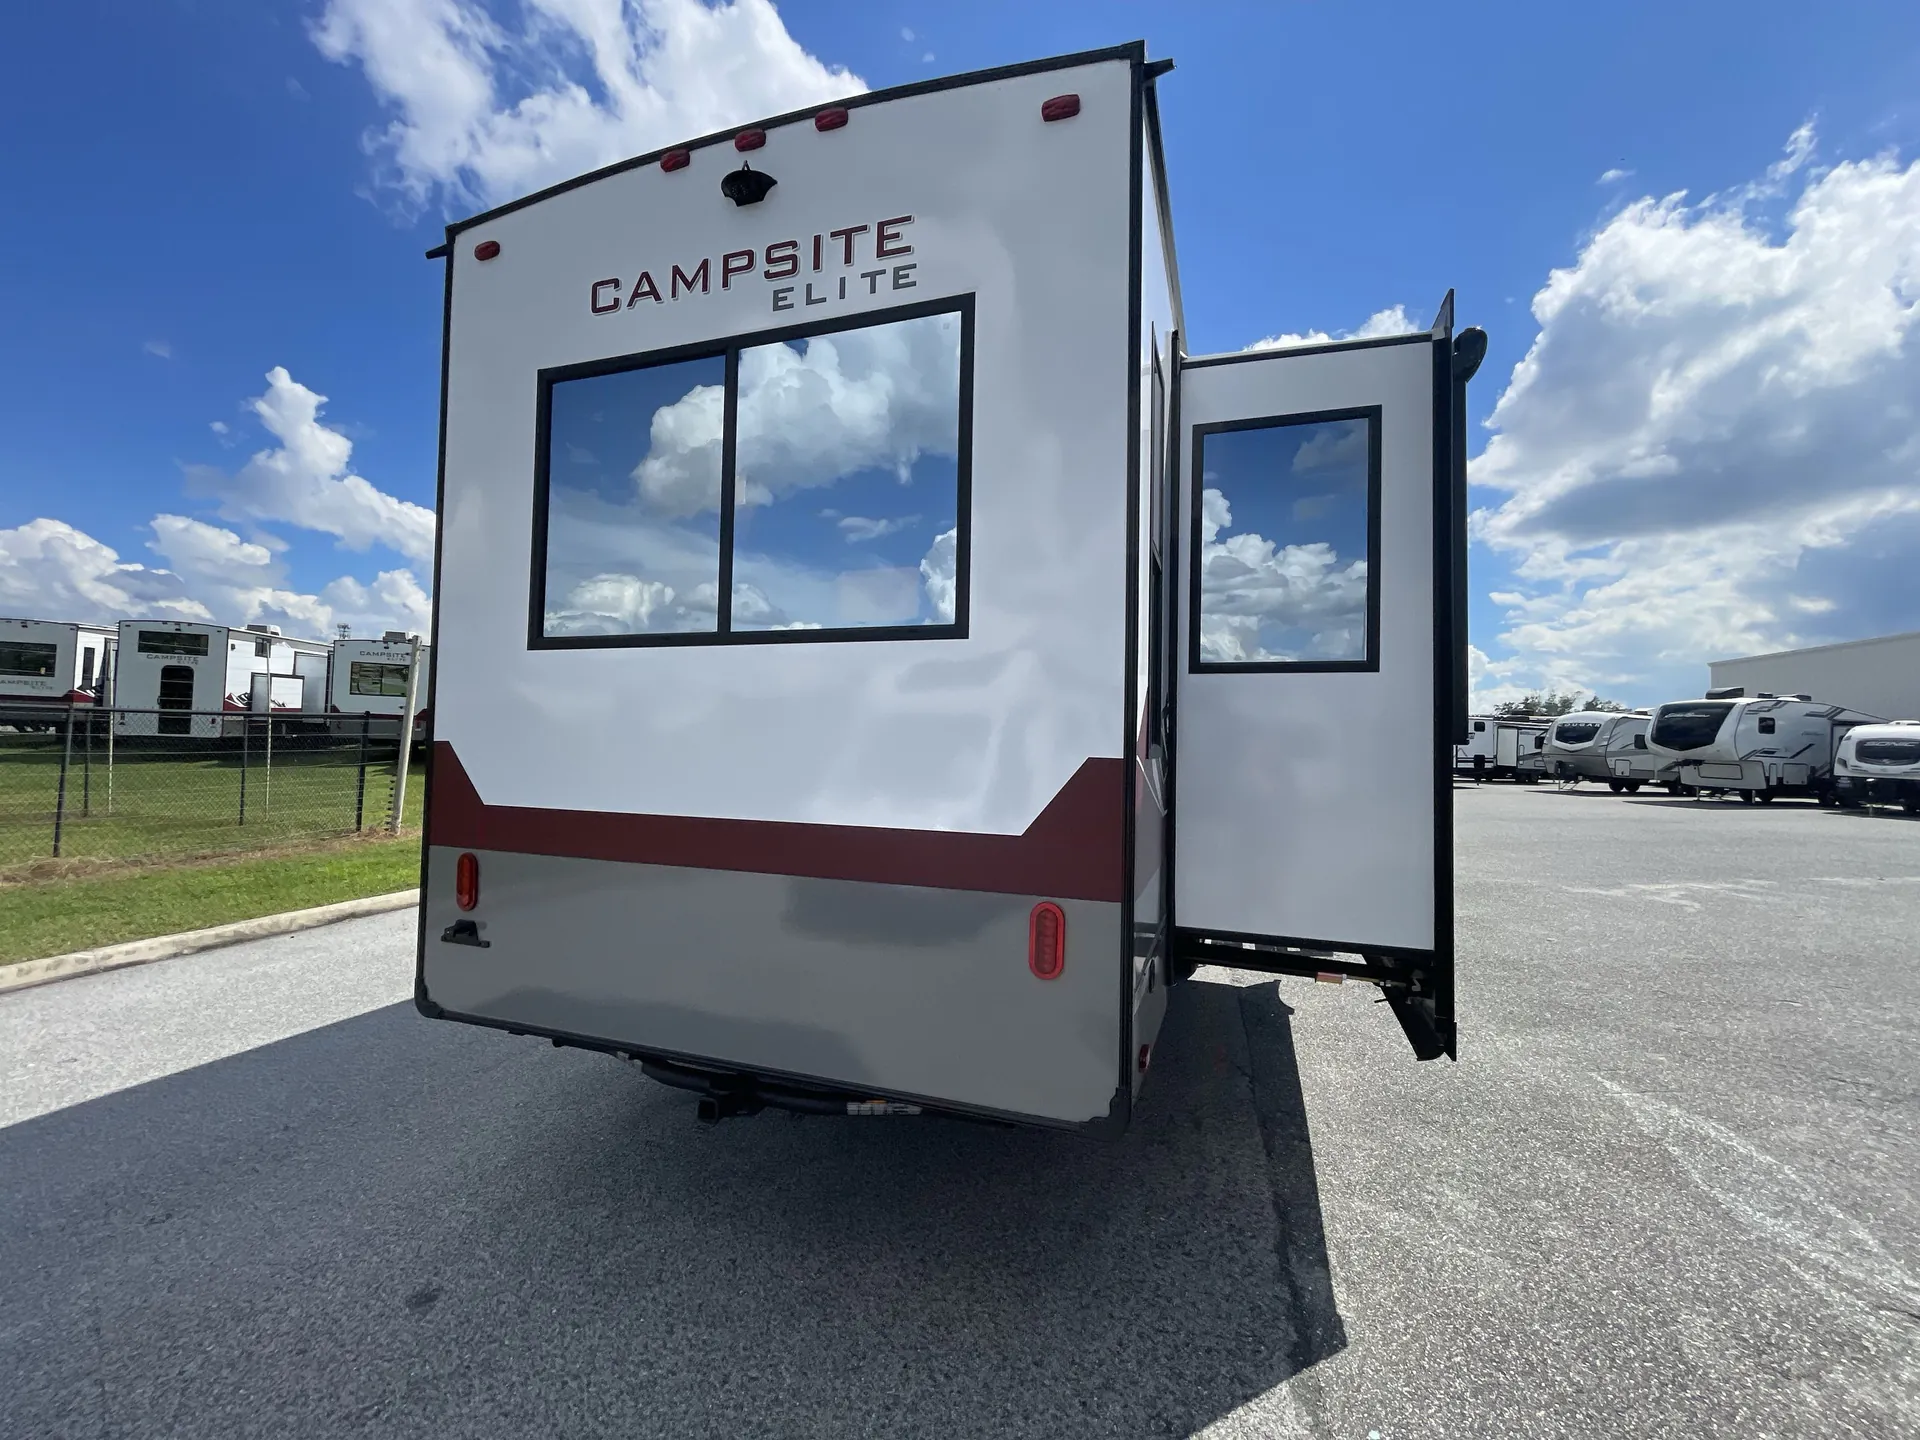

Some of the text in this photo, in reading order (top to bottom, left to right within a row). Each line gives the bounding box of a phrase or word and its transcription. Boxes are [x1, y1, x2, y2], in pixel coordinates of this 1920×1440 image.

[590, 214, 915, 315] CAMPSITE
[772, 263, 918, 312] ELITE
[146, 653, 200, 662] CAMPSITE
[360, 650, 406, 659] CAMPSITE
